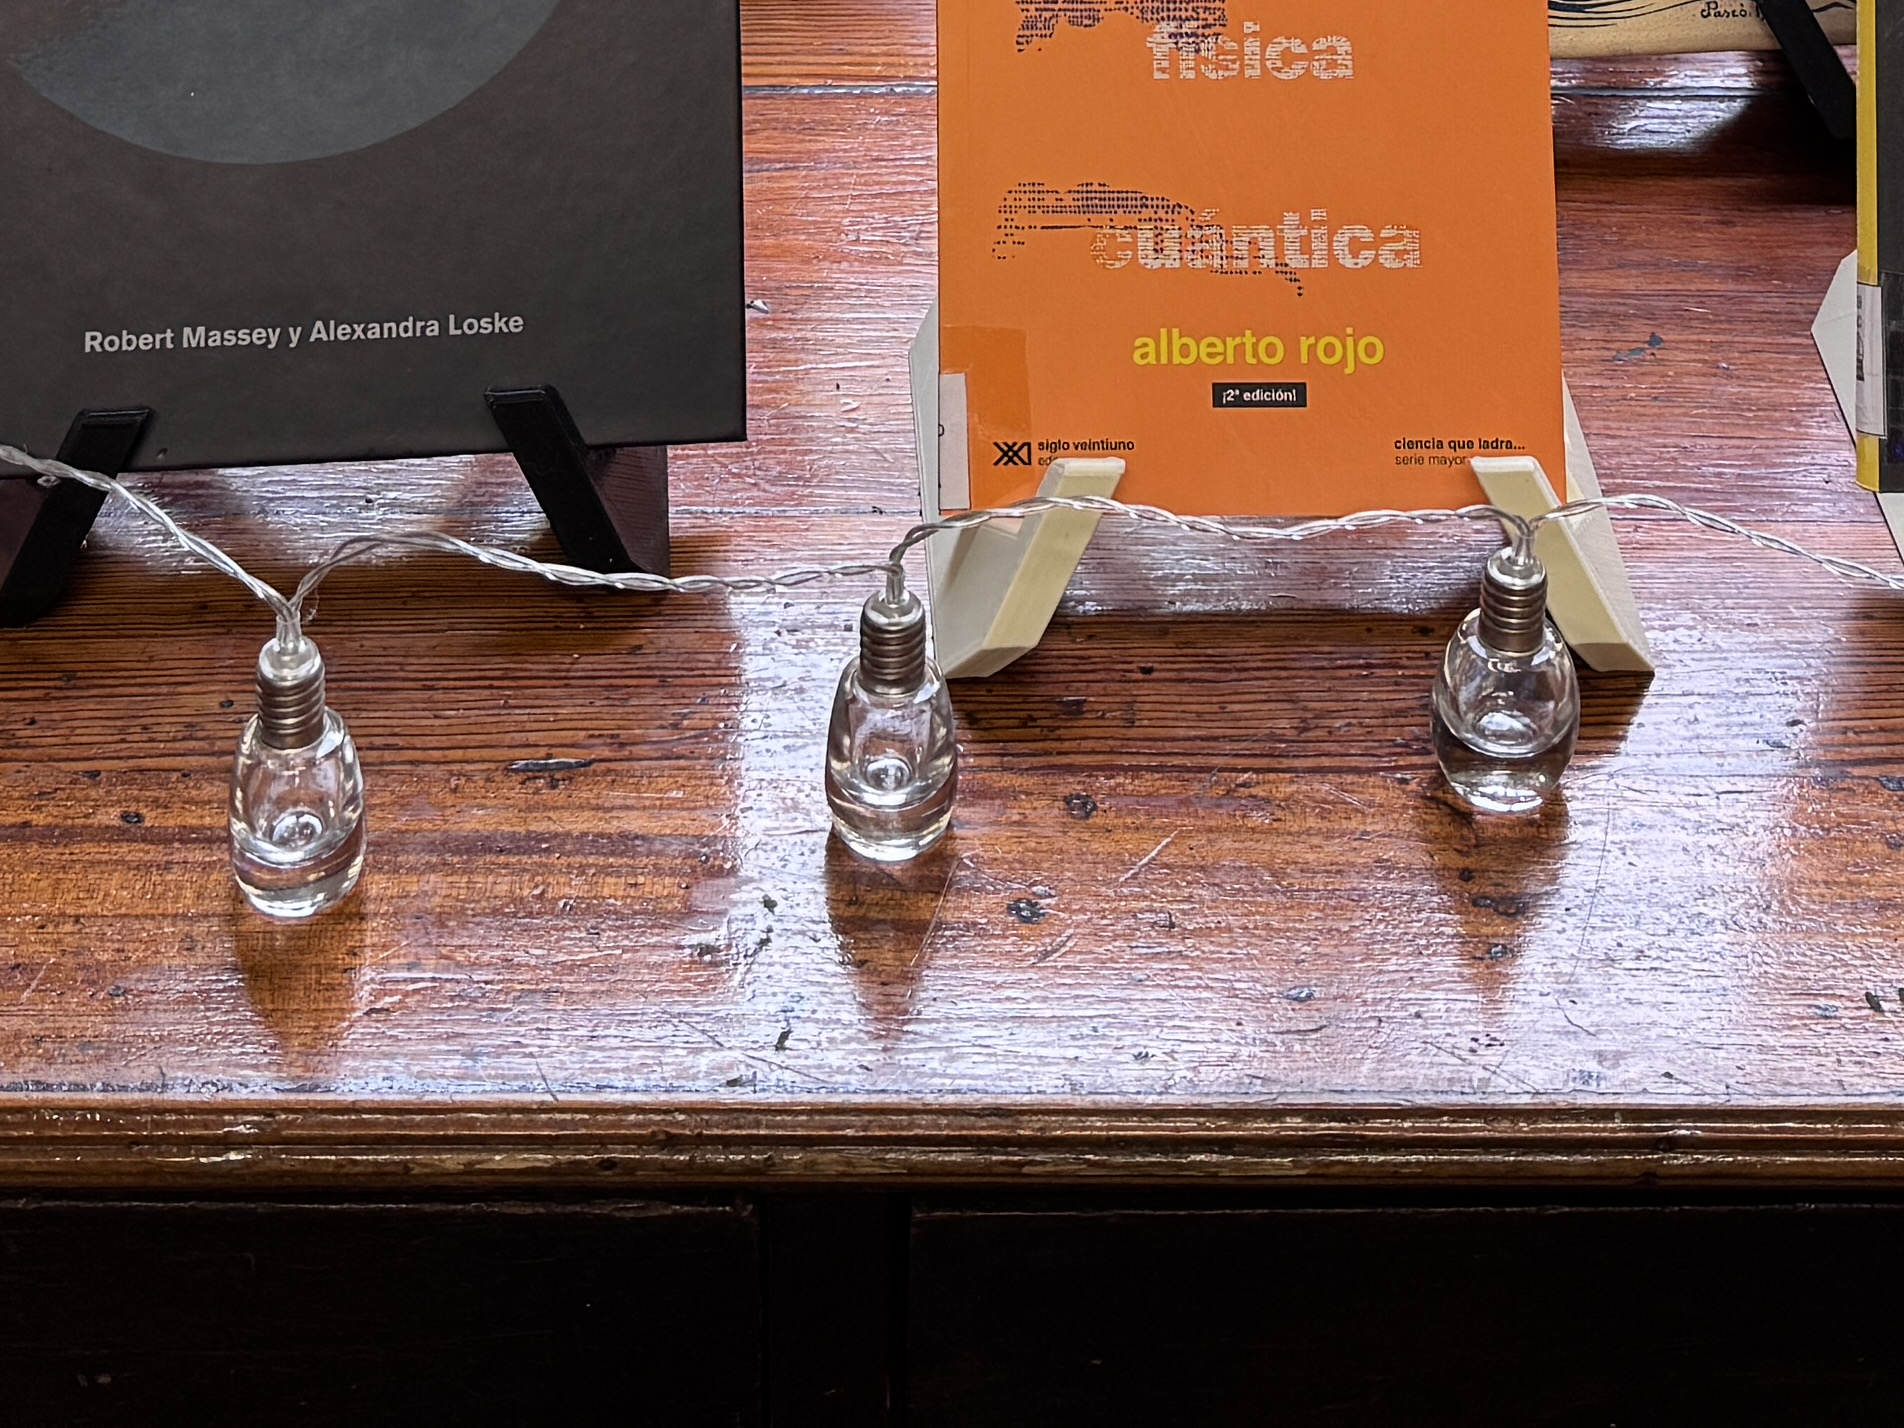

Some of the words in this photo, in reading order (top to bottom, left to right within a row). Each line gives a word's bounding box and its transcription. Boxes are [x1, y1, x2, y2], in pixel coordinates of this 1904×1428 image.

[1090, 207, 1423, 270] cuántica
[84, 327, 175, 353] Robert
[182, 324, 281, 349] Massey
[288, 324, 302, 348] y
[309, 316, 440, 342] Alexandra
[448, 311, 525, 336] Loske
[1132, 327, 1286, 366] alberto
[1299, 327, 1386, 375] rojo
[1242, 388, 1298, 404] edición!
[1037, 438, 1071, 454] siglo
[1072, 437, 1136, 451] veintiuno
[1394, 436, 1445, 451] ciencia
[1447, 439, 1475, 454] que
[1477, 436, 1527, 451] ladra...
[1394, 452, 1426, 466] serie
[1428, 454, 1468, 469] mayor
